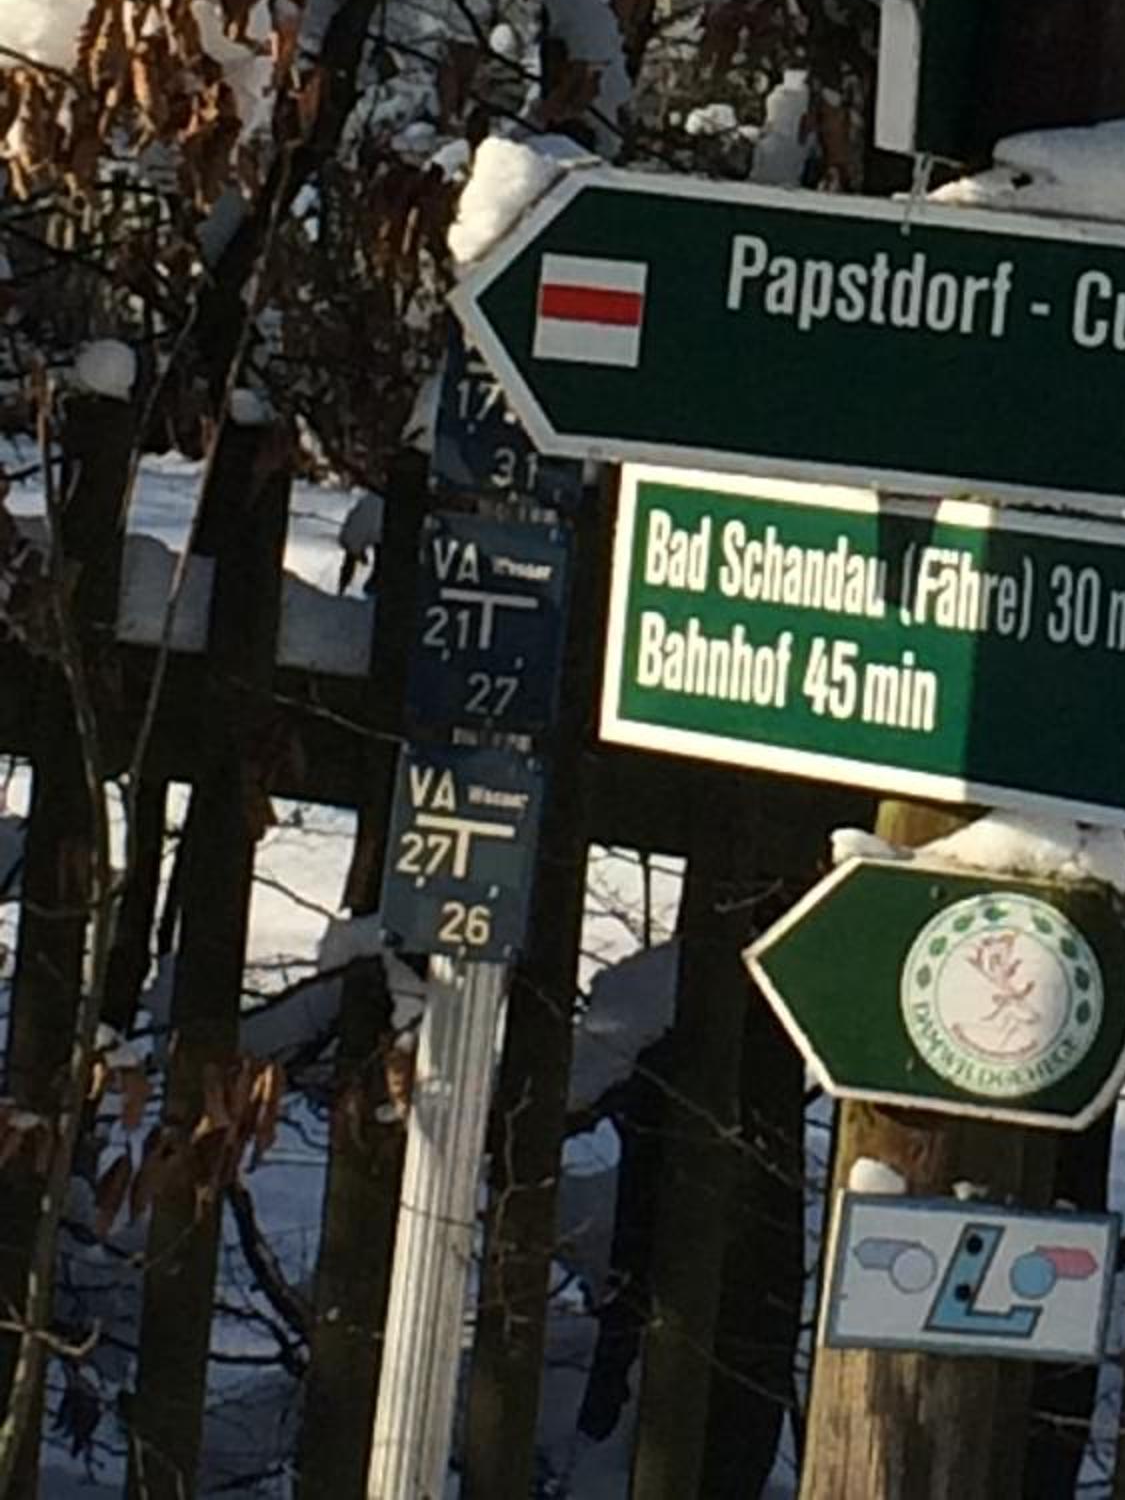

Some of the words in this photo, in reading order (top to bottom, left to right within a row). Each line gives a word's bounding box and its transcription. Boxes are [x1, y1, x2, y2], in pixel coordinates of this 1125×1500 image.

[727, 234, 1013, 338] Papstdorf
[431, 537, 481, 585] VA
[644, 508, 712, 593] Bad
[718, 518, 888, 619] Schandau
[899, 542, 1034, 642] (Fähre)
[1047, 564, 1101, 647] 30
[636, 610, 794, 709] Bahnhof
[802, 636, 859, 720] 45
[861, 650, 938, 732] min
[408, 764, 457, 812] VA
